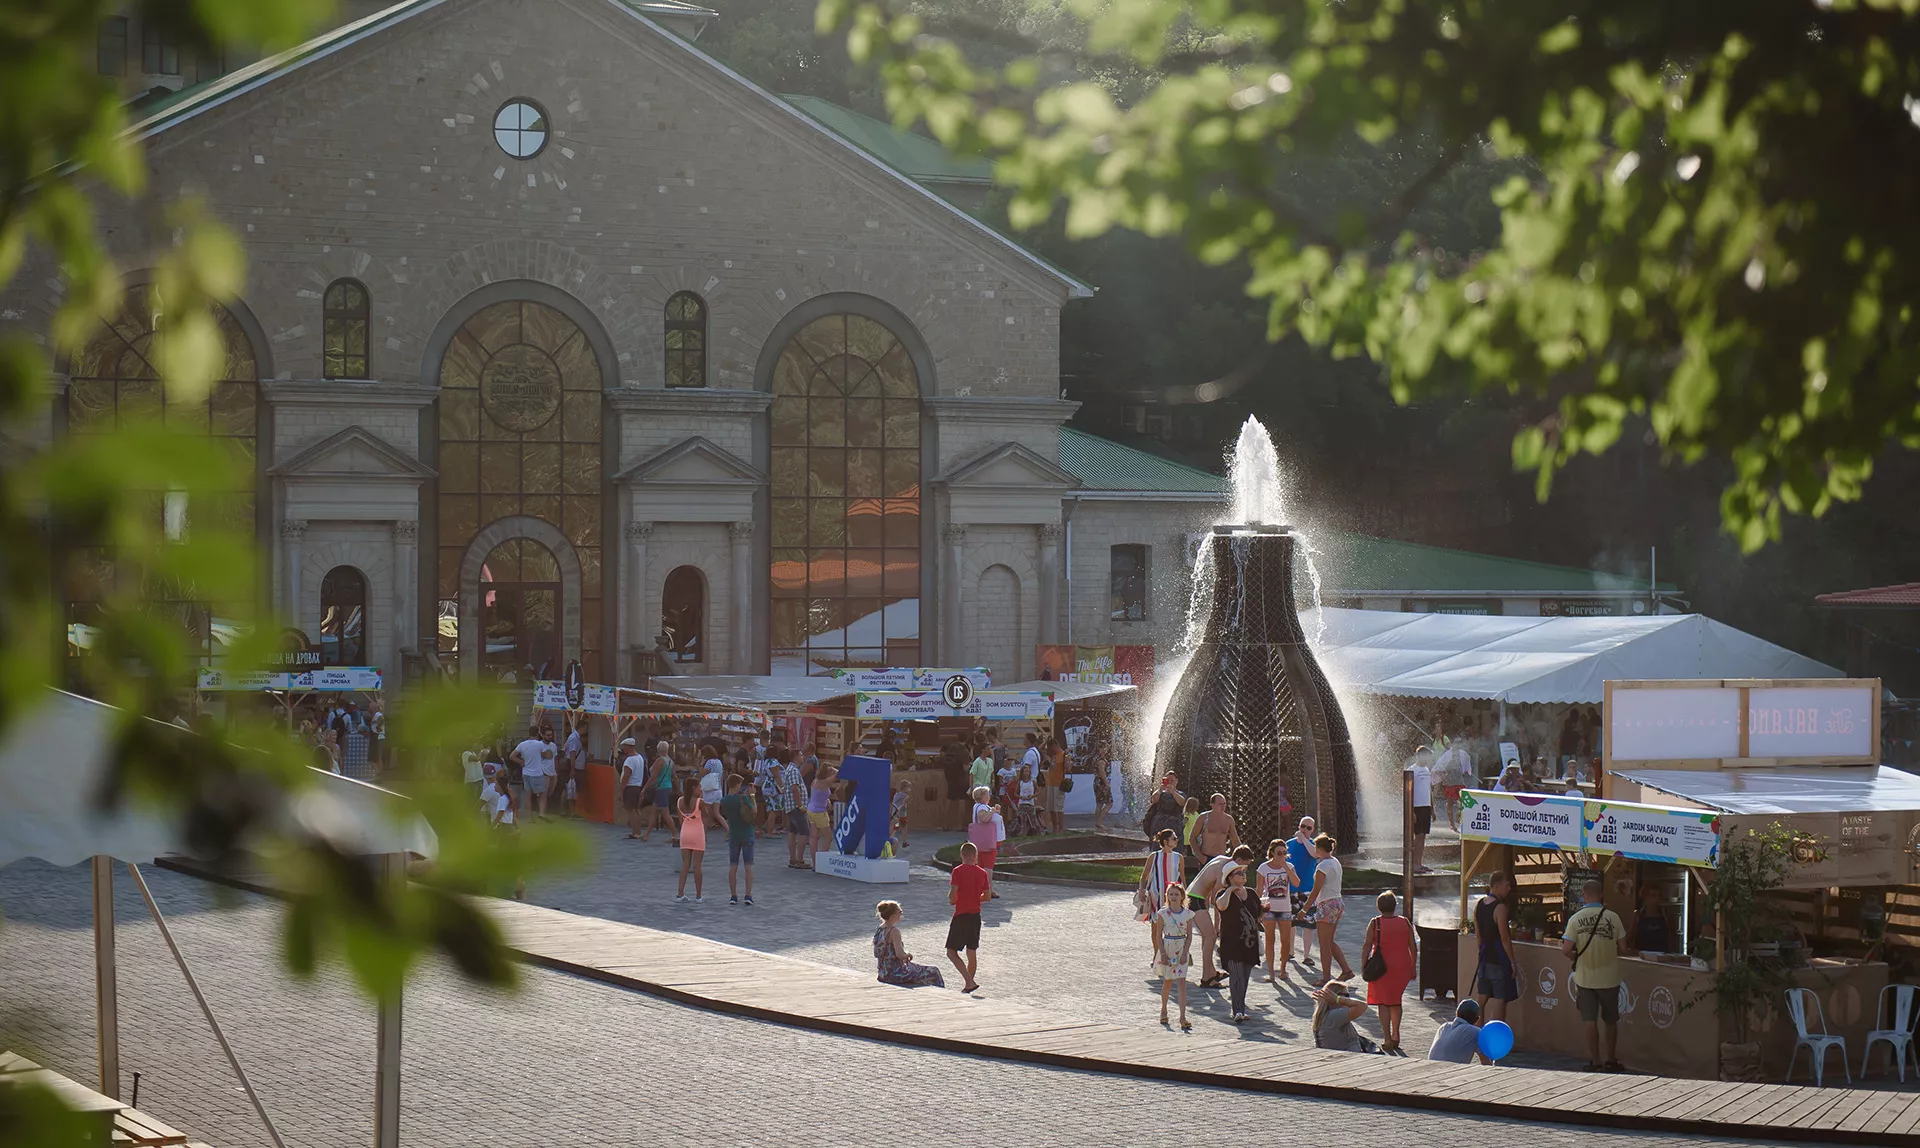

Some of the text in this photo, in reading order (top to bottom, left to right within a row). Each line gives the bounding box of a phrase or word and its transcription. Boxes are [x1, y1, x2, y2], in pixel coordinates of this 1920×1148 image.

[296, 652, 321, 665] ДРОВАХ
[1077, 656, 1113, 673] The Life
[953, 686, 964, 700] DS
[836, 795, 860, 848] РОСТ
[1476, 812, 1490, 822] да!
[1500, 807, 1570, 826] БОЛЬШОЙ ЛЕТНИЙ
[1842, 816, 1873, 825] A TASTE
[1470, 820, 1490, 831] еда!
[1512, 822, 1557, 836] ФЕСТИВАЛЬ
[1602, 824, 1617, 835] да!
[1622, 821, 1678, 836] JARDIN SAUVAGE/
[1842, 826, 1870, 836] OF THE
[1596, 834, 1617, 844] еда!
[1630, 833, 1654, 846] ДИКИЙ
[1654, 836, 1670, 848] САД
[828, 857, 857, 870] ПАРТИЯ РОСТА
